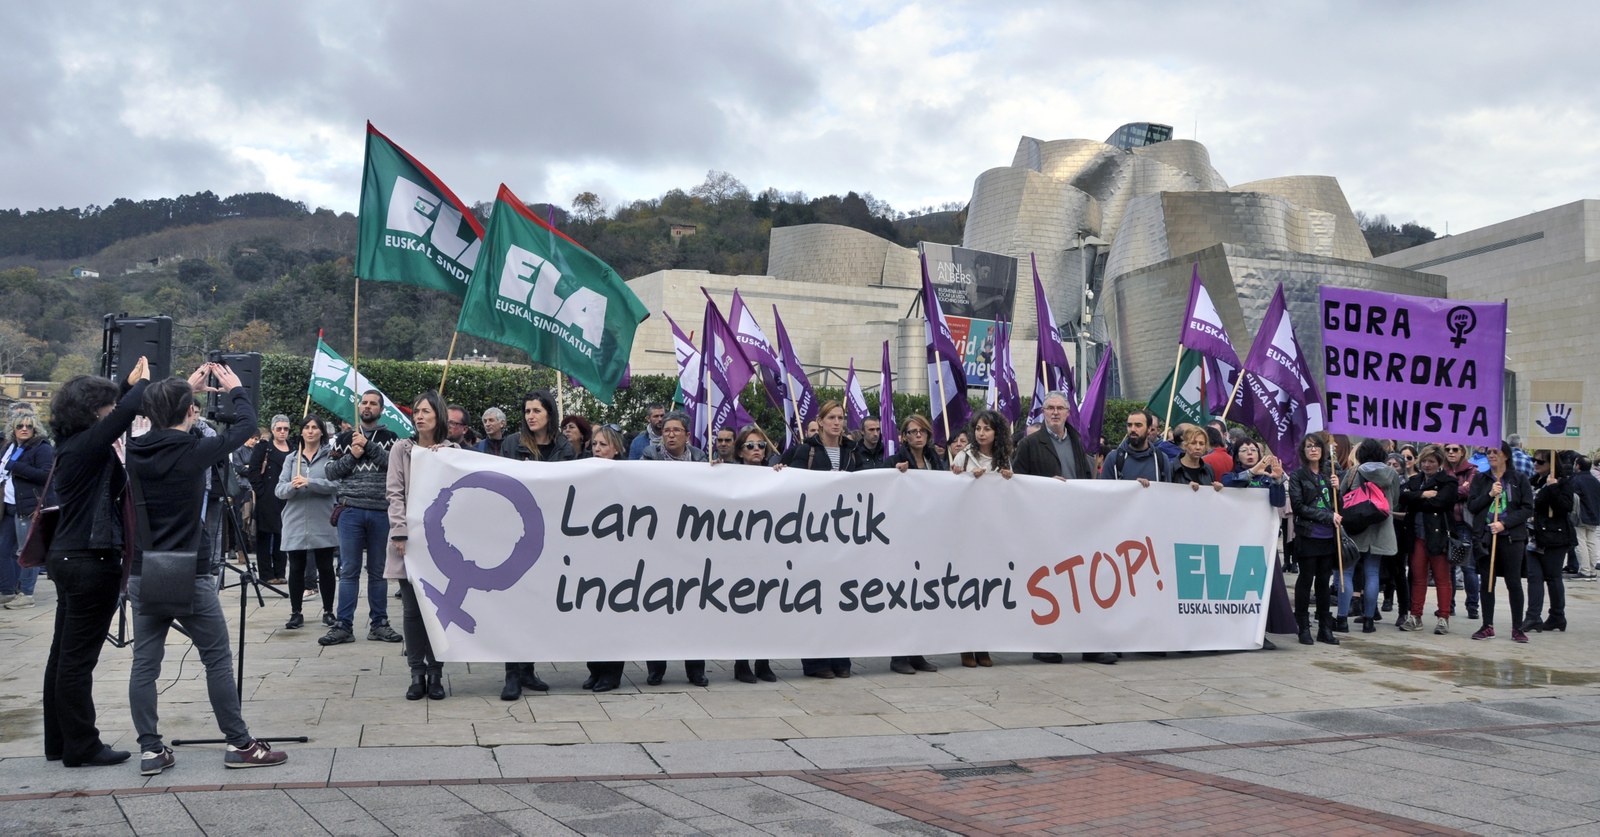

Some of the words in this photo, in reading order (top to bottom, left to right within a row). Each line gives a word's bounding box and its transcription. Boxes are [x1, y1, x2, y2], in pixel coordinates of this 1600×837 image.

[385, 235, 433, 258] EUSKAL
[436, 255, 471, 286] SINDI
[937, 261, 962, 273] ANNI
[937, 271, 971, 285] ALBERS
[499, 244, 608, 349] ELA
[496, 299, 533, 323] EUSKAL
[533, 316, 592, 358] SINDIKATUA
[1190, 321, 1229, 345] EUSKAL
[1324, 300, 1410, 339] GORA
[736, 335, 770, 354] EUSKAL
[954, 335, 977, 356] vid
[1266, 348, 1300, 379] EUSKAL
[1325, 345, 1476, 390] BORROKA
[315, 380, 346, 397] SKAL
[1246, 373, 1269, 408] EUSKAL
[1327, 391, 1489, 437] FEMINISTA
[560, 485, 658, 543] Lan
[676, 492, 890, 545] mundutik
[556, 555, 822, 614] indarkeria
[838, 561, 1017, 614] sexistari
[1026, 536, 1164, 626] STOP!
[1174, 543, 1267, 600] ELA
[1178, 603, 1212, 615] EUSKAL
[1214, 603, 1261, 615] SINDIKAT
